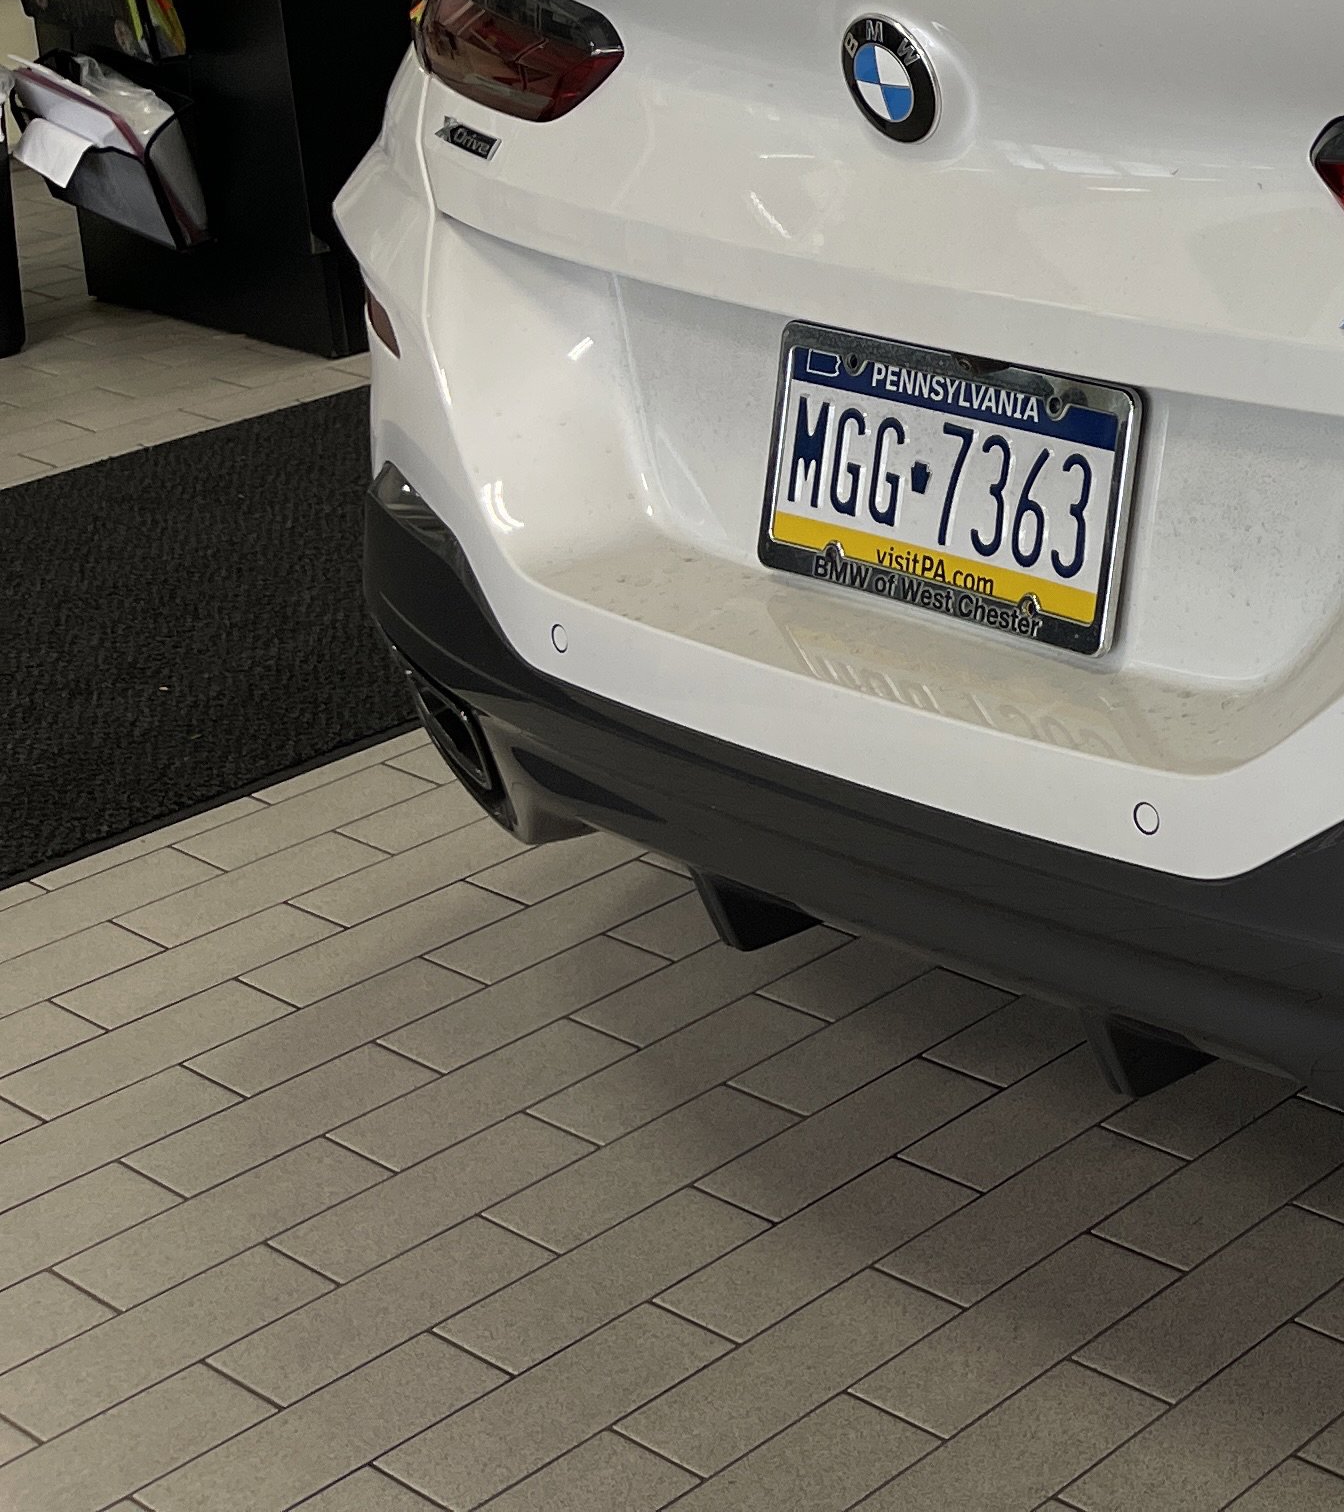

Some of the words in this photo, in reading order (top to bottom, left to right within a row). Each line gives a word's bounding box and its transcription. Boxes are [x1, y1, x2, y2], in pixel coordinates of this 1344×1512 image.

[872, 362, 1039, 423] PENNSYLVANIA
[813, 555, 873, 589] BMW
[874, 574, 896, 597] of
[901, 577, 953, 613] West
[958, 594, 1042, 638] Chester
[876, 546, 995, 596] visitPA.com
